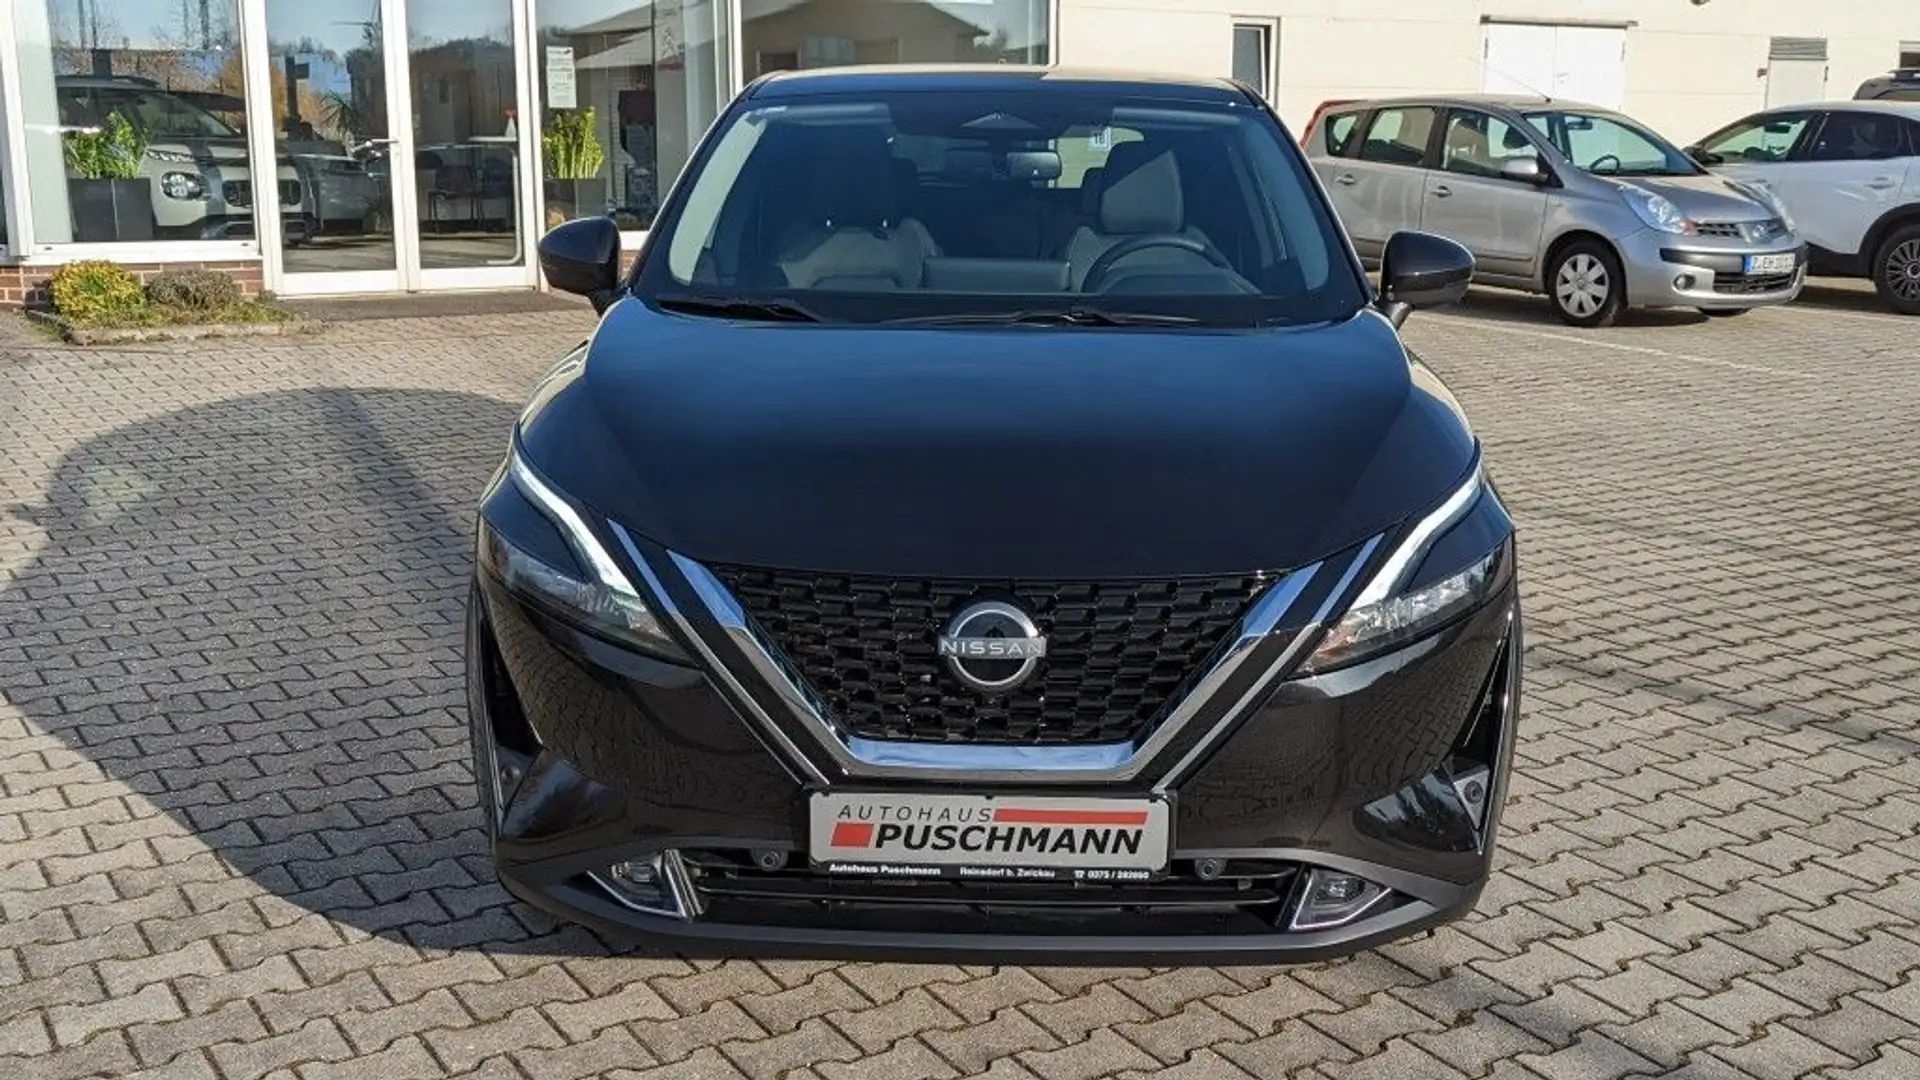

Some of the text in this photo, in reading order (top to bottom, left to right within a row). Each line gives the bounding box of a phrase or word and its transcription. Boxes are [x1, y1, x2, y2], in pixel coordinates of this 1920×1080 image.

[941, 641, 1041, 655] NISSAN
[838, 804, 991, 823] AUTOHAUS
[875, 823, 1143, 854] PUSCHMANN
[829, 864, 878, 873] Autohaus
[881, 866, 941, 876] Puschmann
[1017, 868, 1055, 877] Zwickau
